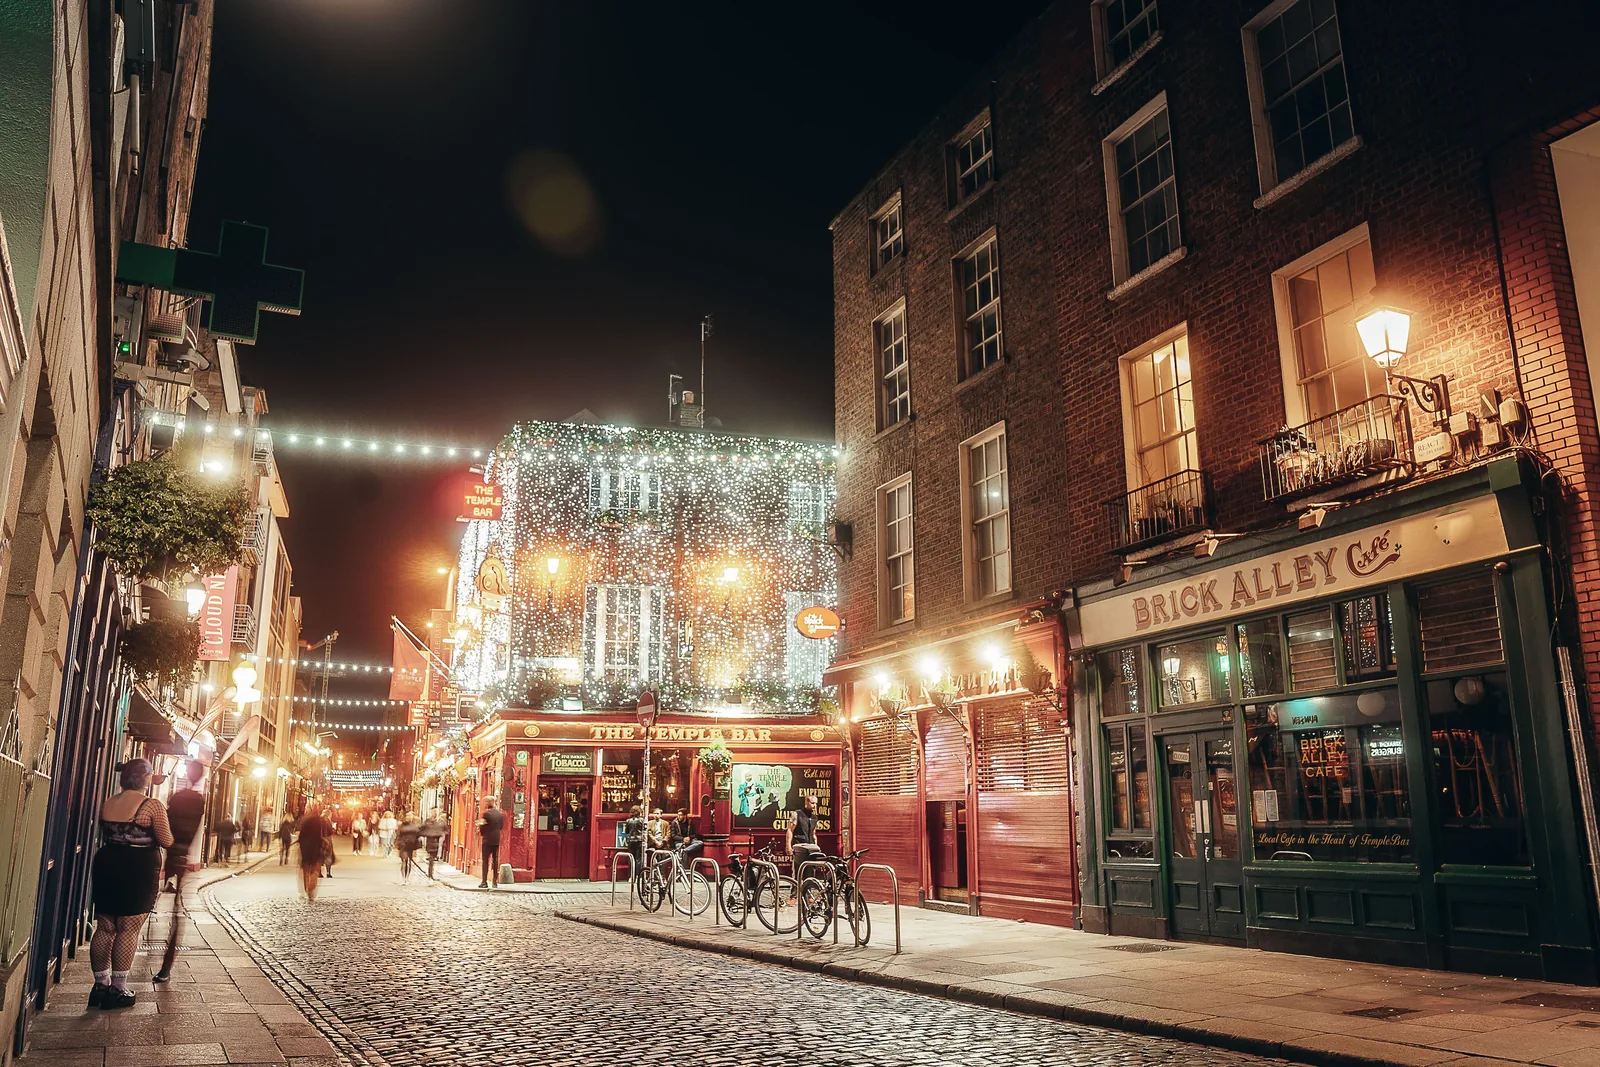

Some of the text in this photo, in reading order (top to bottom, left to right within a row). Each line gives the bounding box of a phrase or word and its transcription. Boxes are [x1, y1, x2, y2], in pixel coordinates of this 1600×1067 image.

[474, 485, 493, 495] THE
[465, 496, 501, 505] TEMPLE
[473, 508, 492, 516] BAR
[1132, 578, 1223, 631] BRICK
[1230, 547, 1338, 610] ALLEY
[204, 595, 224, 645] CLOUD
[590, 726, 771, 741] THE TEMPLE BAR
[1301, 736, 1343, 750] BRICK
[1302, 751, 1344, 763] ALLEY
[816, 780, 830, 788] THE
[799, 788, 830, 797] EMPEROR
[821, 798, 830, 806] OF
[1258, 832, 1279, 843] Local
[1297, 835, 1305, 844] in
[1308, 833, 1319, 844] the
[1321, 833, 1346, 845] Heart
[1349, 835, 1359, 848] of
